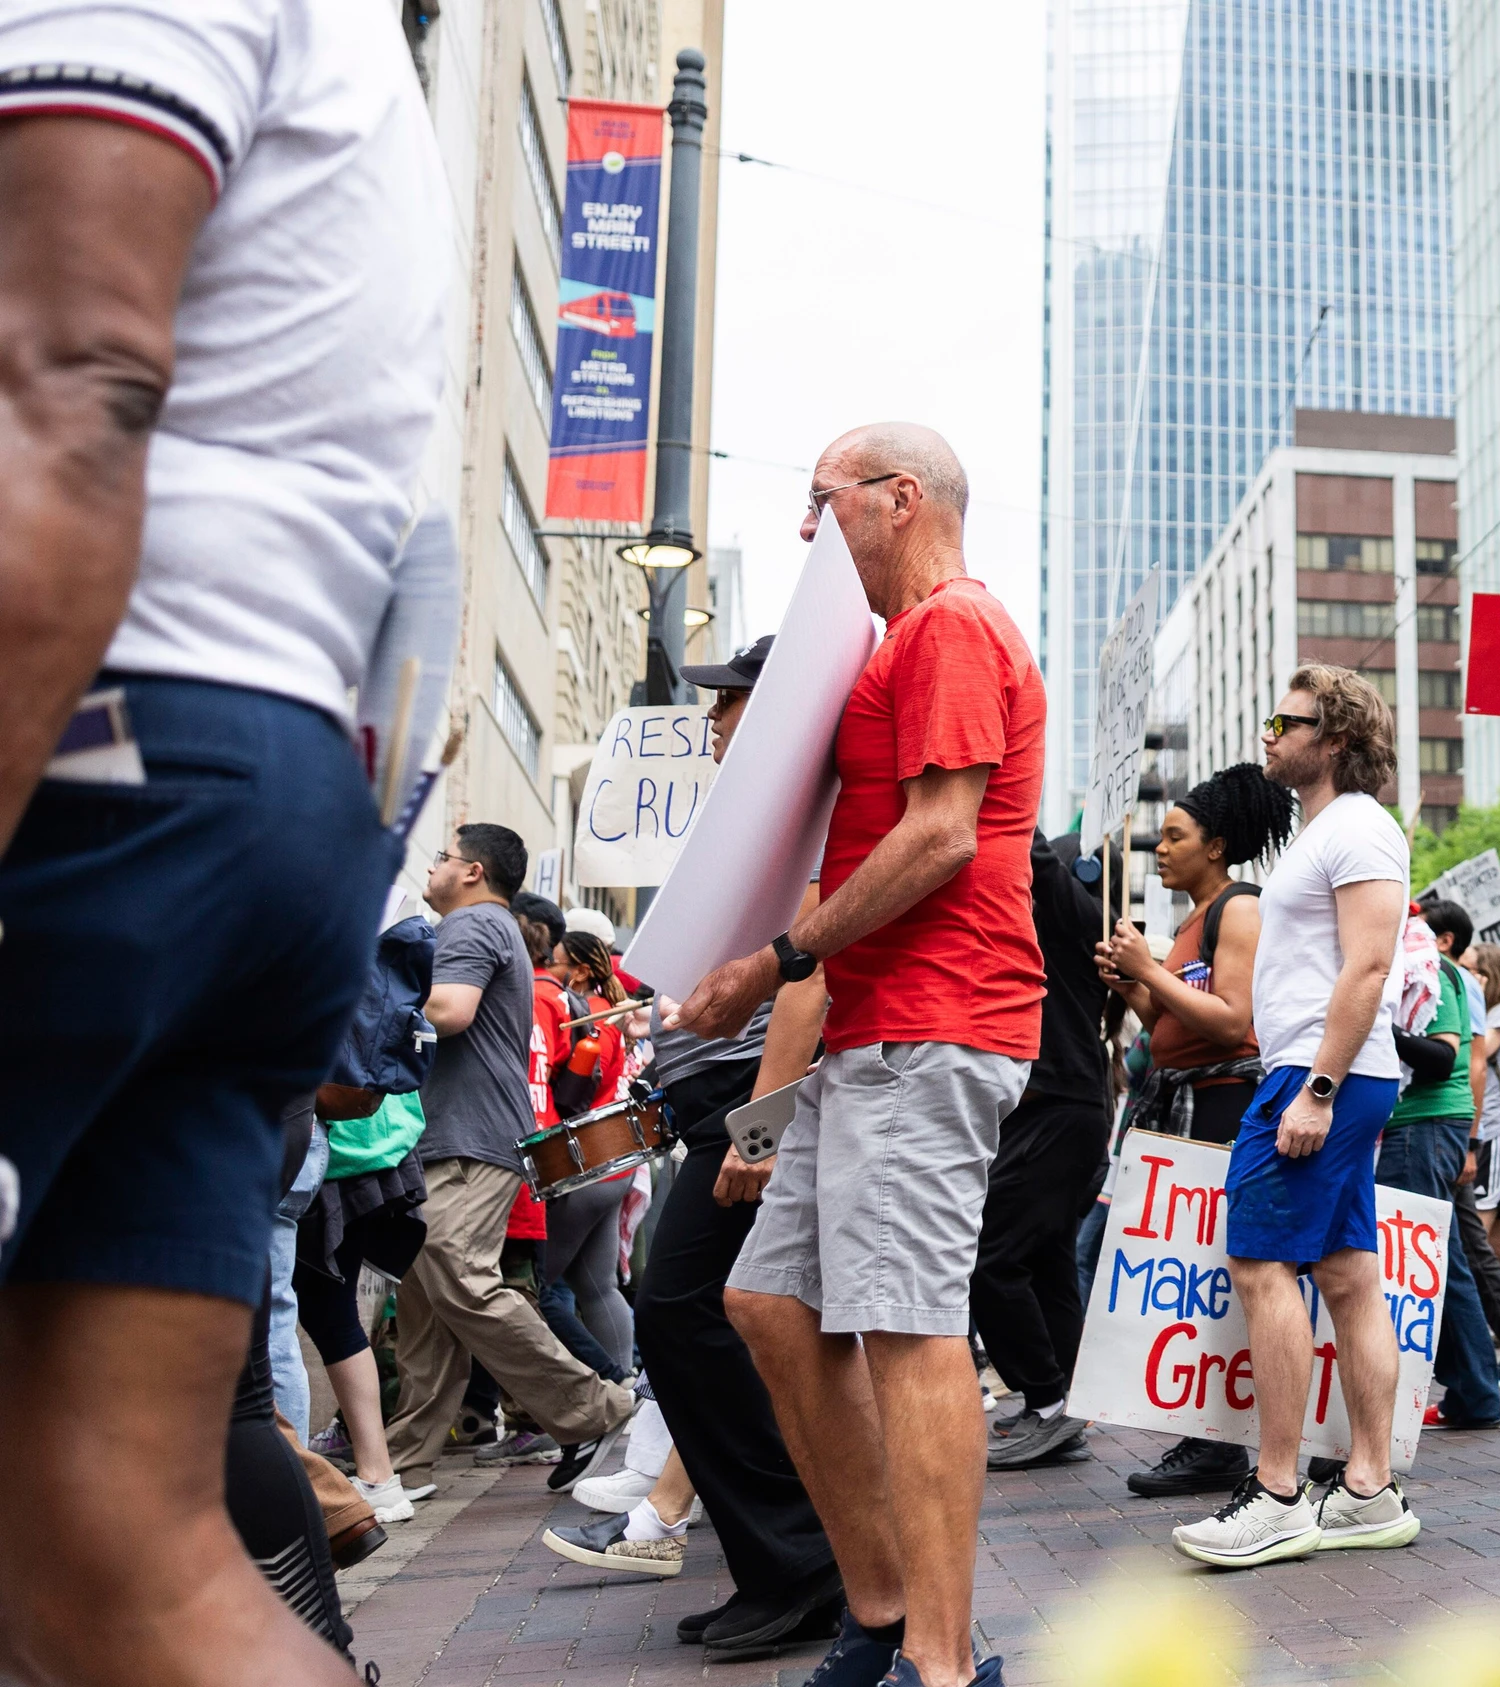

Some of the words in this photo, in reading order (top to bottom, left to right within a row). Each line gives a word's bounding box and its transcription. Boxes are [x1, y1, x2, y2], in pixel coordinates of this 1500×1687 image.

[582, 201, 643, 219] ENJOY
[587, 218, 636, 235] MAIN
[571, 232, 650, 253] STREET!
[1109, 1248, 1231, 1320] Make
